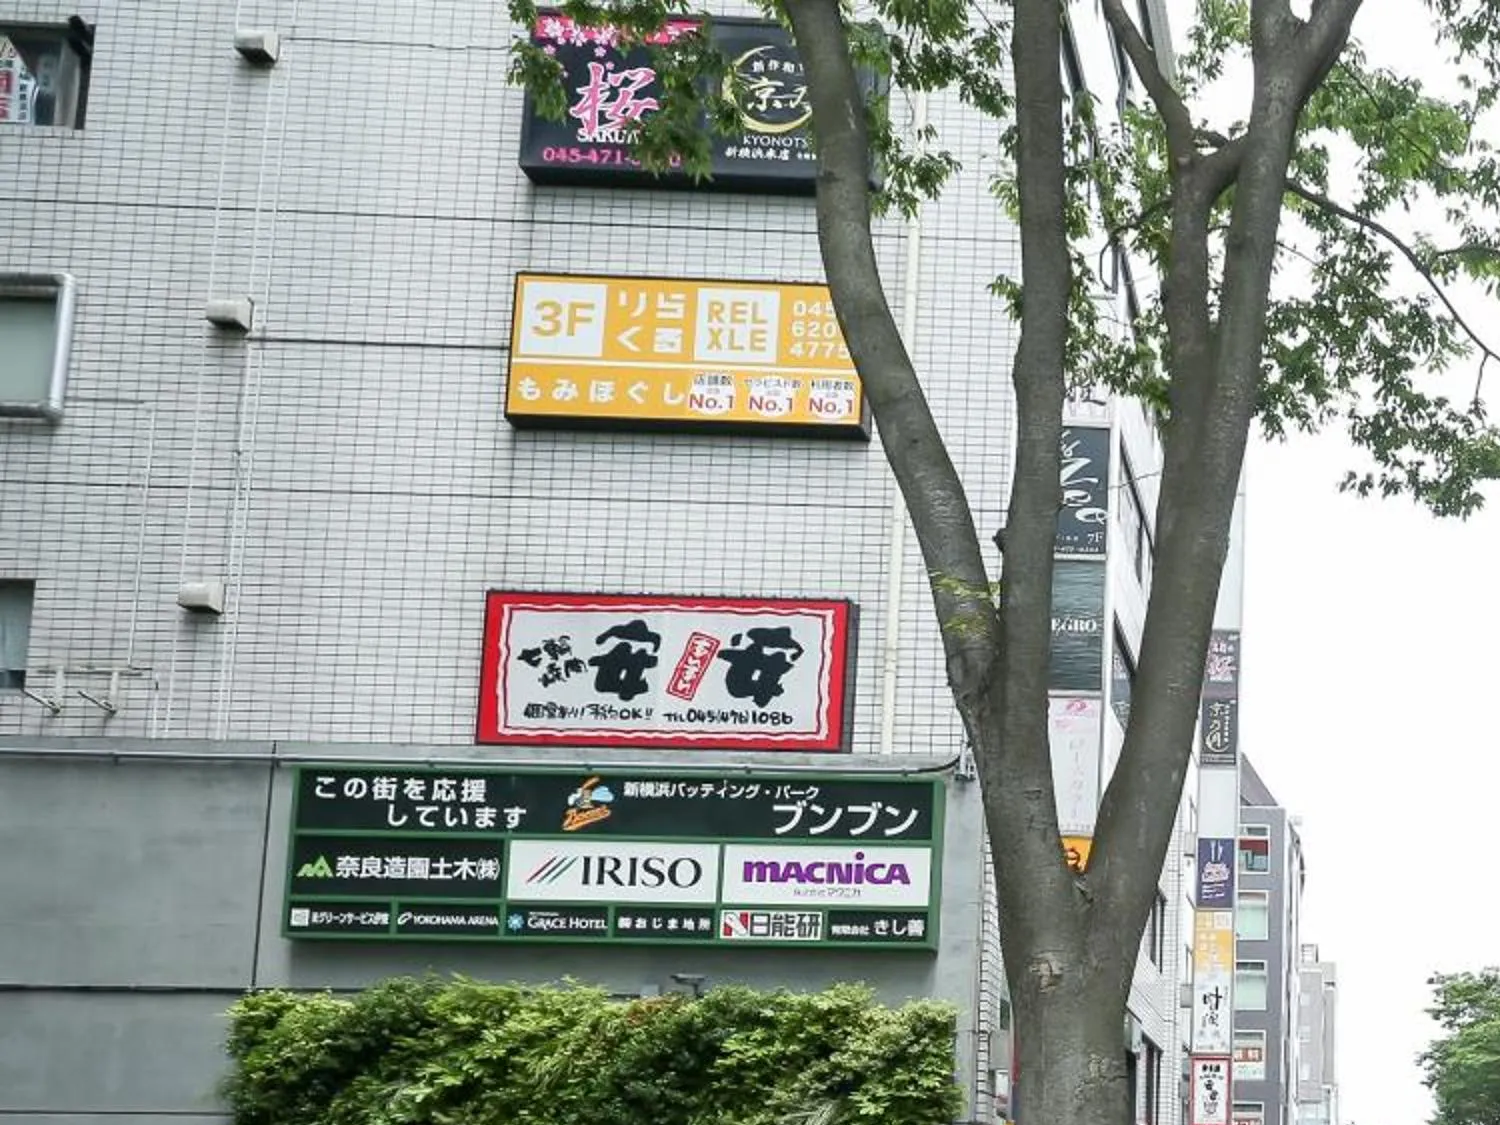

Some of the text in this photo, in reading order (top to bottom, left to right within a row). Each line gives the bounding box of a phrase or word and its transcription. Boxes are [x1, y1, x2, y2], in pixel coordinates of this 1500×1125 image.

[569, 62, 660, 135] 桜
[532, 299, 597, 338] 3F
[707, 301, 769, 325] REL
[706, 328, 769, 352] XLE
[518, 376, 685, 404] もみほぐし
[689, 394, 734, 409] No.1
[749, 396, 792, 412] No.1
[809, 398, 853, 414] No.1
[315, 776, 487, 803] この街を応援
[388, 804, 527, 828] しています
[772, 801, 919, 836] ブンブン
[581, 855, 702, 889] IRISO
[527, 917, 566, 931] GRACE
[751, 913, 821, 938] 日能研
